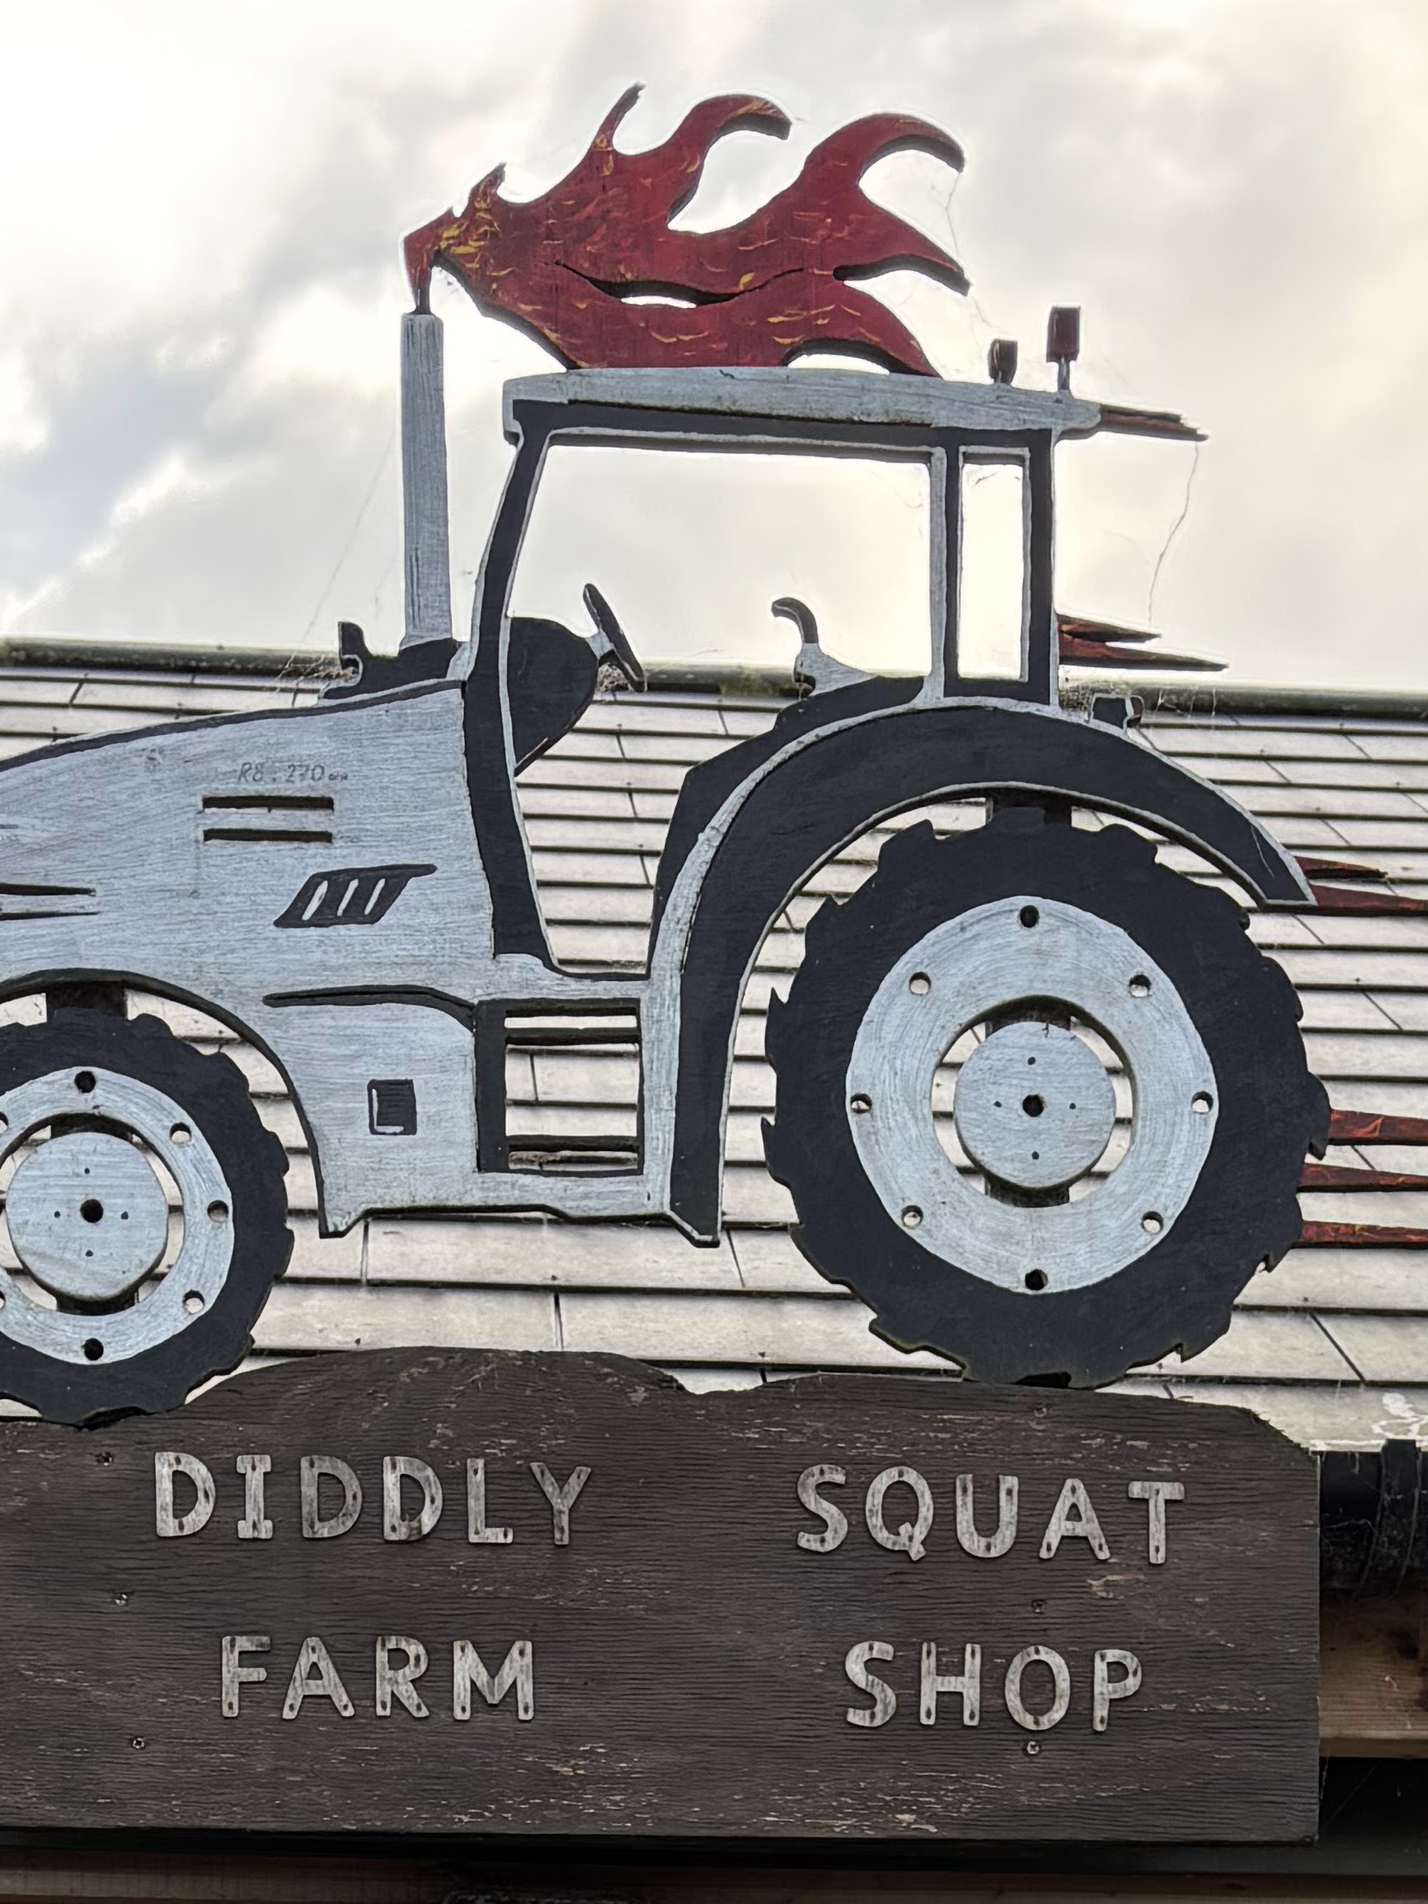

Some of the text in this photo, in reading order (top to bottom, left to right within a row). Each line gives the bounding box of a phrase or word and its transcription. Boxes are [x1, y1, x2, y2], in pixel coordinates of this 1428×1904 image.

[153, 1450, 1185, 1566] DIDDLY SQUAT
[220, 1634, 1143, 1733] FARM SHOP
